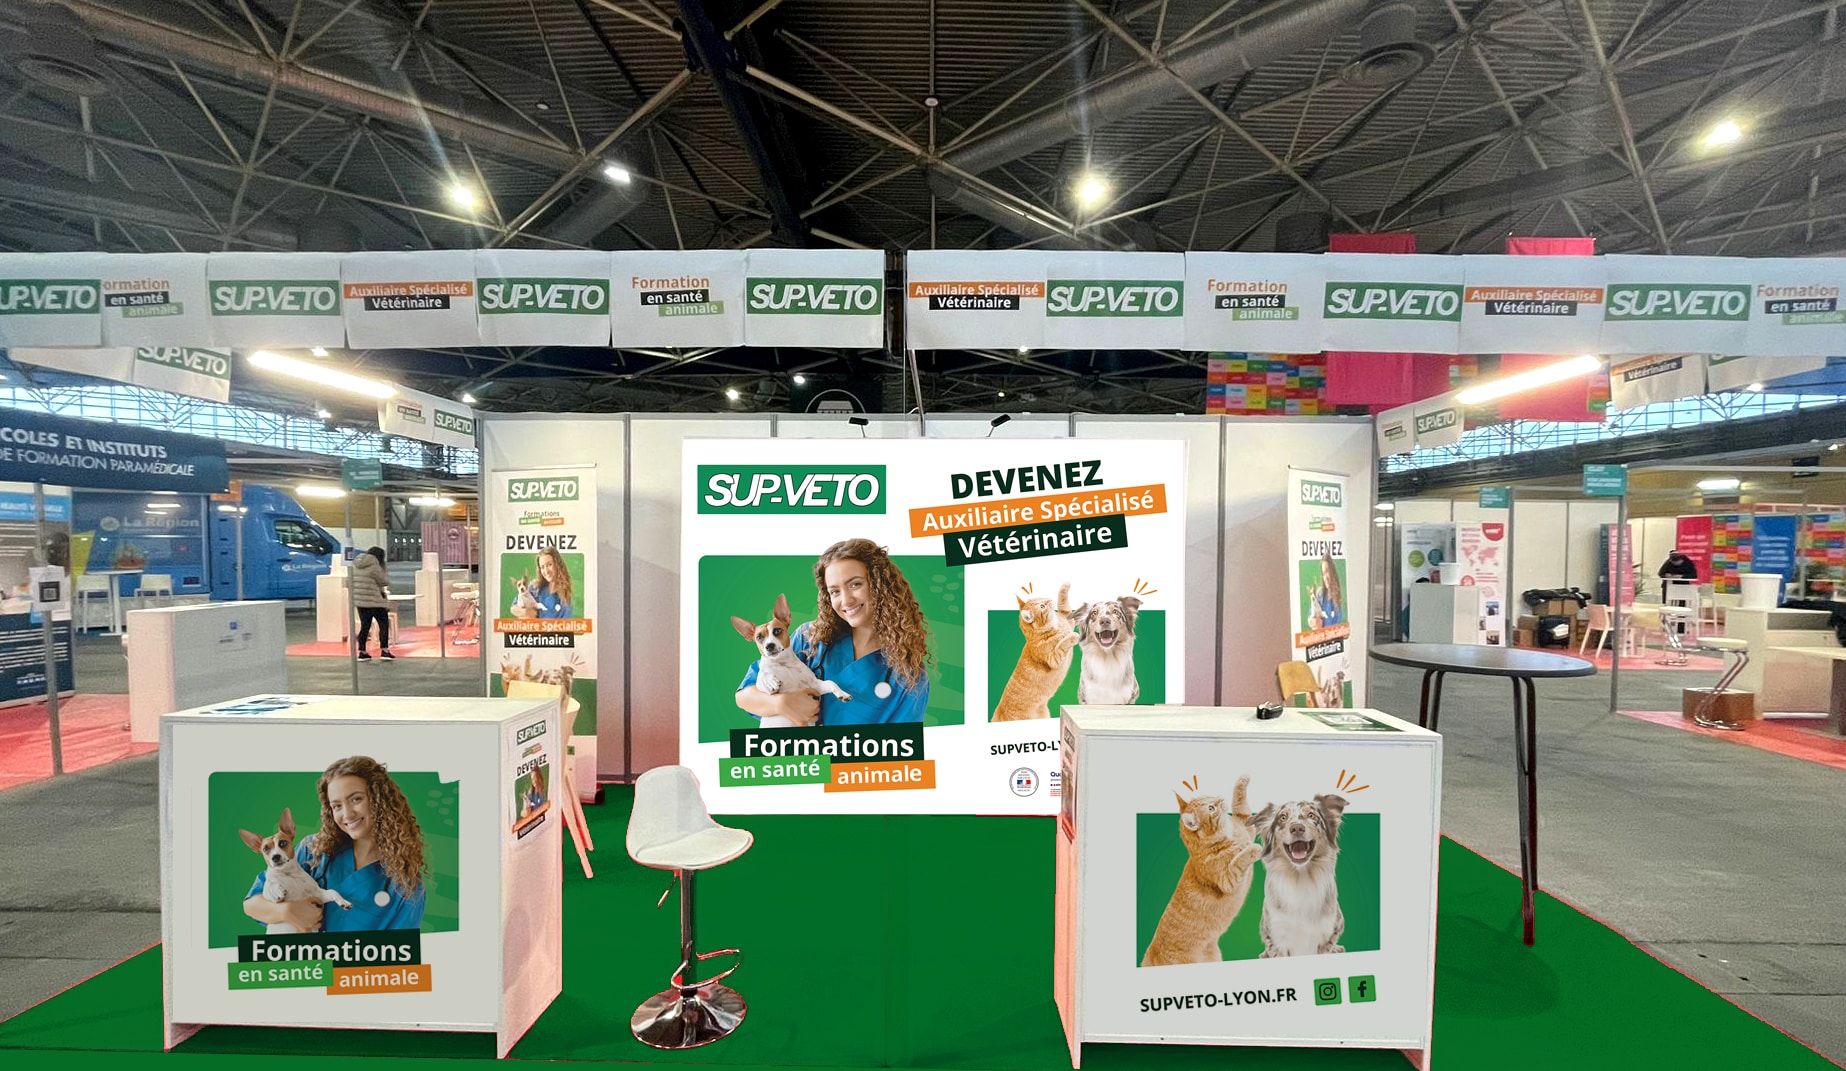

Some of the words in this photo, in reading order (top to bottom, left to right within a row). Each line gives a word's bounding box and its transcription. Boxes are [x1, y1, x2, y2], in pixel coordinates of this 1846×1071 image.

[632, 275, 709, 288] Formation
[1207, 279, 1287, 293] Formation
[351, 284, 407, 297] Auxiliaire
[410, 282, 467, 297] Spécialisé
[647, 294, 663, 304] en
[667, 290, 703, 302] santé
[915, 284, 975, 297] Auxiliaire
[978, 282, 1039, 297] Spécialisé
[1471, 288, 1533, 301] Auxiliaire
[1535, 287, 1597, 303] Spécialisé
[1757, 283, 1839, 297] Formation
[110, 296, 126, 305] en
[130, 292, 164, 304] santé
[372, 295, 442, 309] Vétérinaire
[937, 294, 1011, 308] Vétérinaire
[1222, 298, 1238, 308] en
[1242, 294, 1279, 307] santé
[1771, 302, 1789, 312] en
[1792, 299, 1831, 311] santé
[129, 304, 178, 316] animale
[665, 303, 717, 315] animale
[1239, 307, 1292, 320] animale
[1494, 300, 1569, 315] Vétérinaire
[65, 435, 82, 450] ET
[86, 439, 168, 459] INSTITUTS
[17, 449, 107, 470] FORMATION
[110, 460, 195, 476] PARAMÉDICALE
[951, 459, 1104, 499] DEVENEZ
[922, 500, 1034, 532] Auxiliaire
[1040, 489, 1155, 525] Spécialisé
[506, 535, 577, 550] DEVENEZ
[957, 523, 1113, 560] Vétérinaire
[1302, 541, 1342, 556] DEVENEZ
[498, 621, 540, 631] Auxiliaire
[542, 621, 587, 632] Spécialisé
[509, 634, 569, 646] Vétérinaire
[745, 733, 914, 757] Formations
[991, 740, 1061, 756] SUPVETO-L
[517, 754, 547, 777] DEVENEZ
[730, 765, 755, 779] en
[762, 758, 820, 778] santé
[837, 765, 922, 784] animale
[252, 939, 412, 962] Formations
[238, 969, 263, 982] en
[268, 963, 324, 982] santé
[339, 970, 419, 988] animale
[1140, 988, 1298, 1013] SUPVETO-LYON.FR
